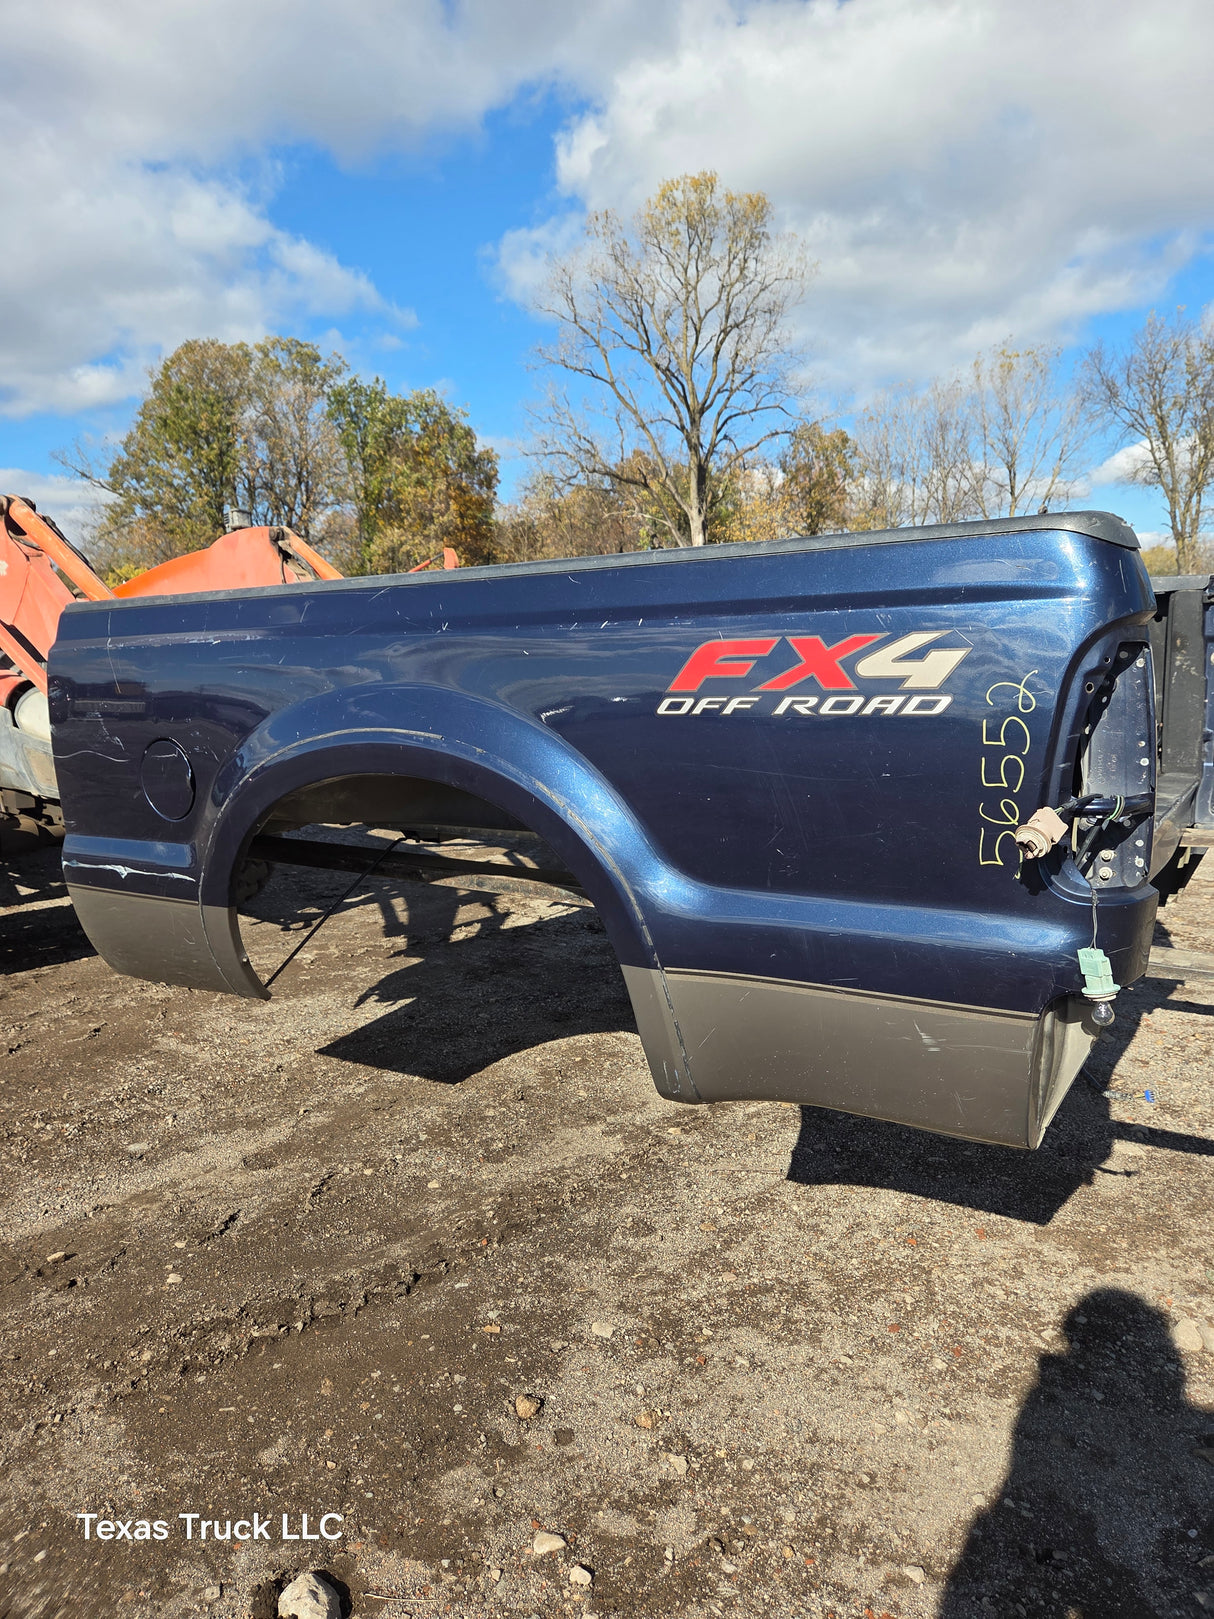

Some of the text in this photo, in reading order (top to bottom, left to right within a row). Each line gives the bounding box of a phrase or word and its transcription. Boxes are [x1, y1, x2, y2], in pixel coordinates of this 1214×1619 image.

[665, 630, 974, 692] FX4
[655, 694, 954, 717] OFF ROAD
[979, 669, 1039, 880] 56552
